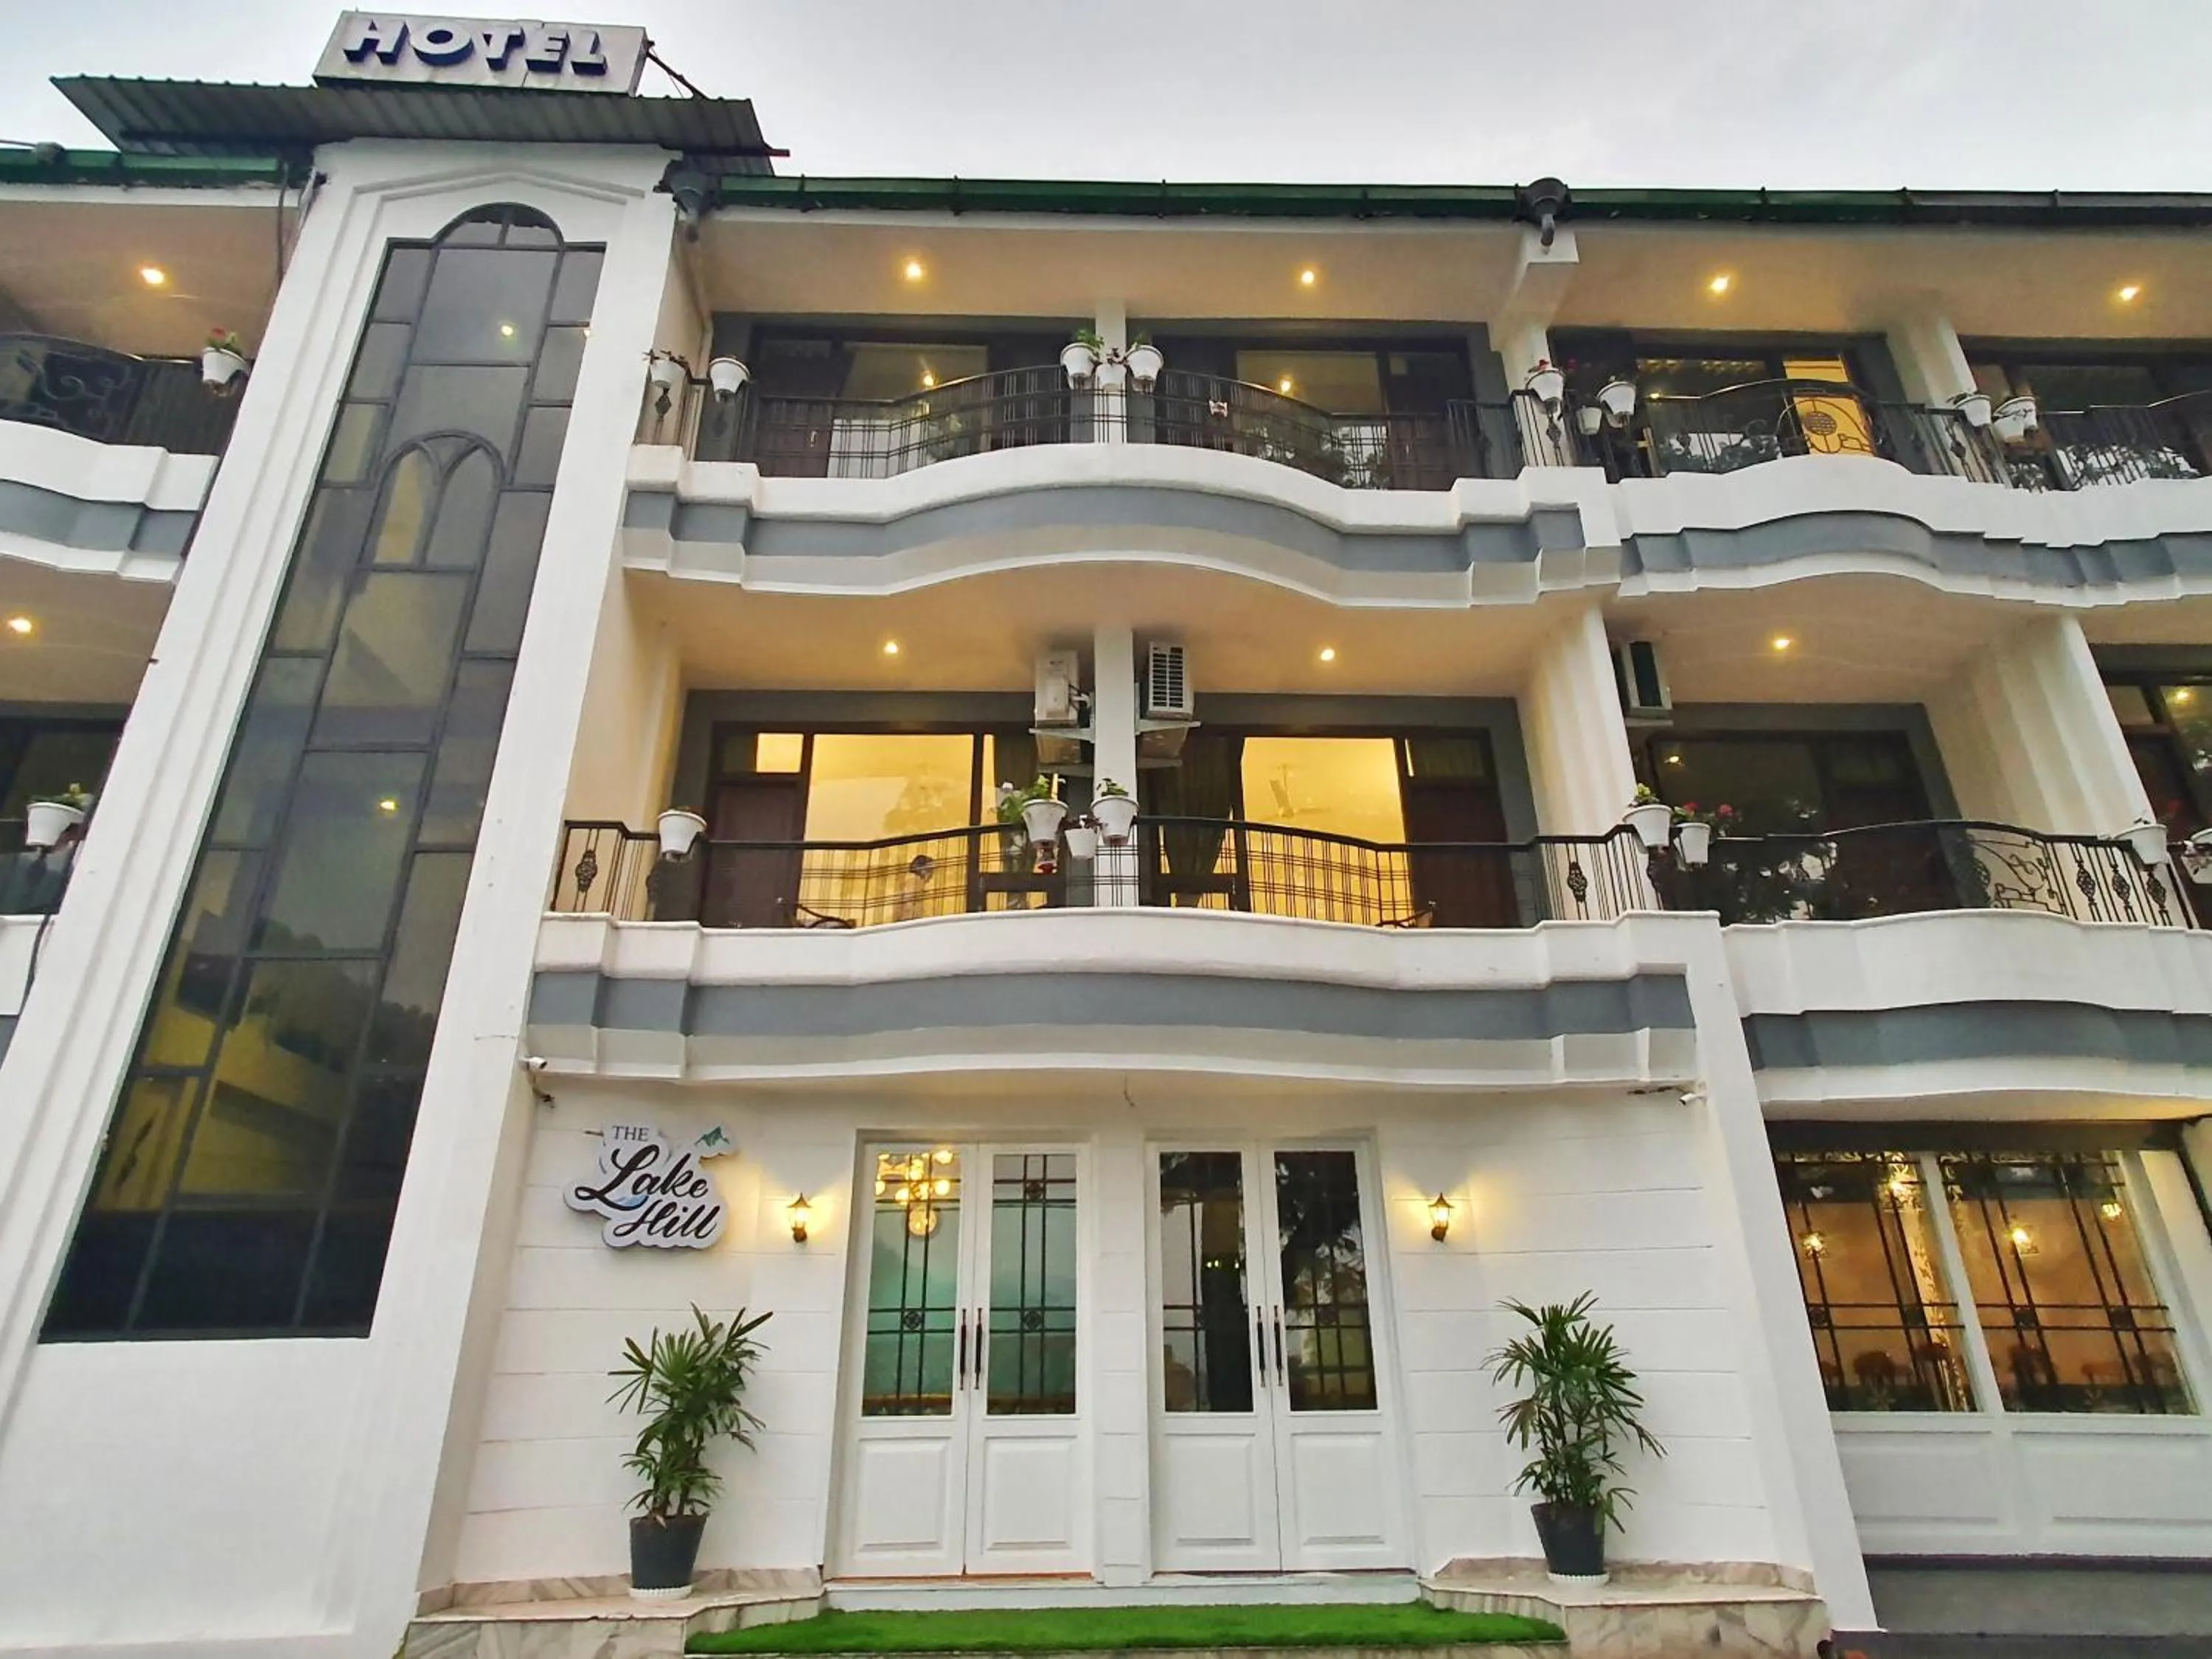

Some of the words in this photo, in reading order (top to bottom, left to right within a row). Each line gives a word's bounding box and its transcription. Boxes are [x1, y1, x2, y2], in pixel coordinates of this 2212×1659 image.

[343, 19, 606, 75] HOTEL
[612, 1125, 649, 1142] THE
[574, 1144, 709, 1211] Lake
[613, 1199, 720, 1239] Hill
